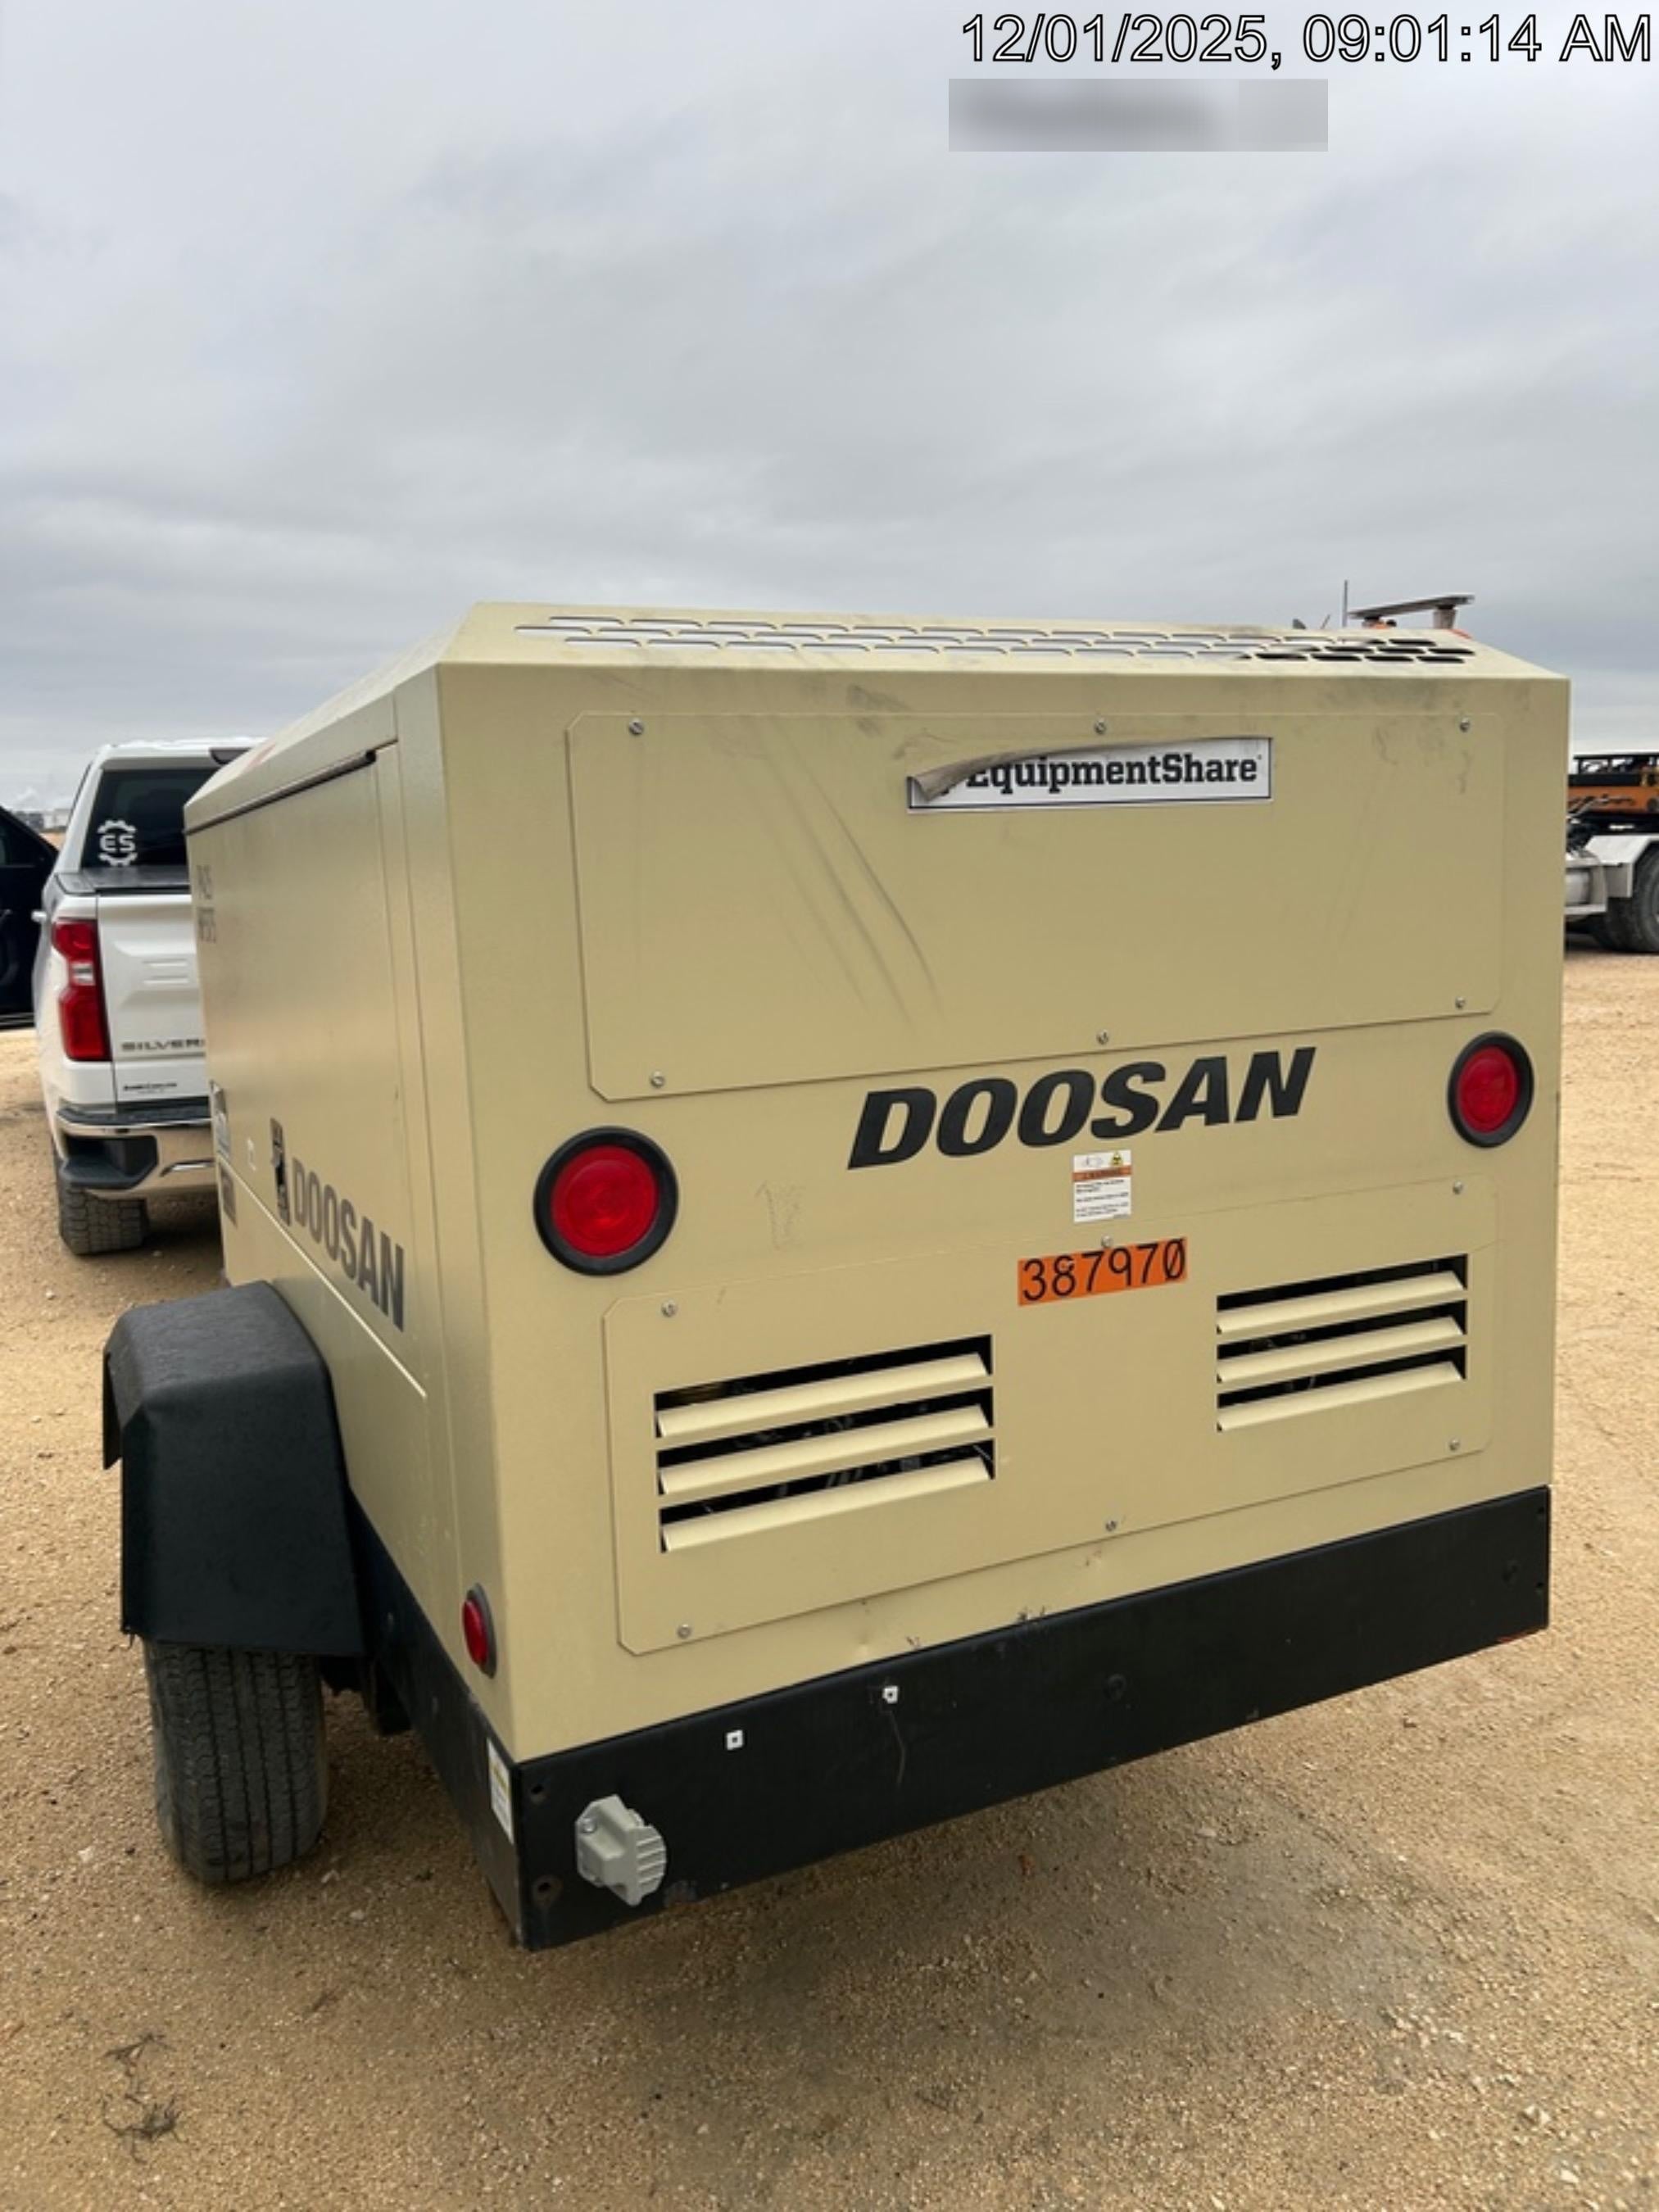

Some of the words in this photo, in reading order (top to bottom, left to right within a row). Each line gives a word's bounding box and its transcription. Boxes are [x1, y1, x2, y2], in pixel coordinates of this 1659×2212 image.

[100, 834, 136, 853] ES
[122, 1039, 206, 1052] SILVER
[847, 1046, 1316, 1170] DOOSAN
[292, 1156, 404, 1333] DOOSAN
[1022, 1237, 1185, 1301] 387970
